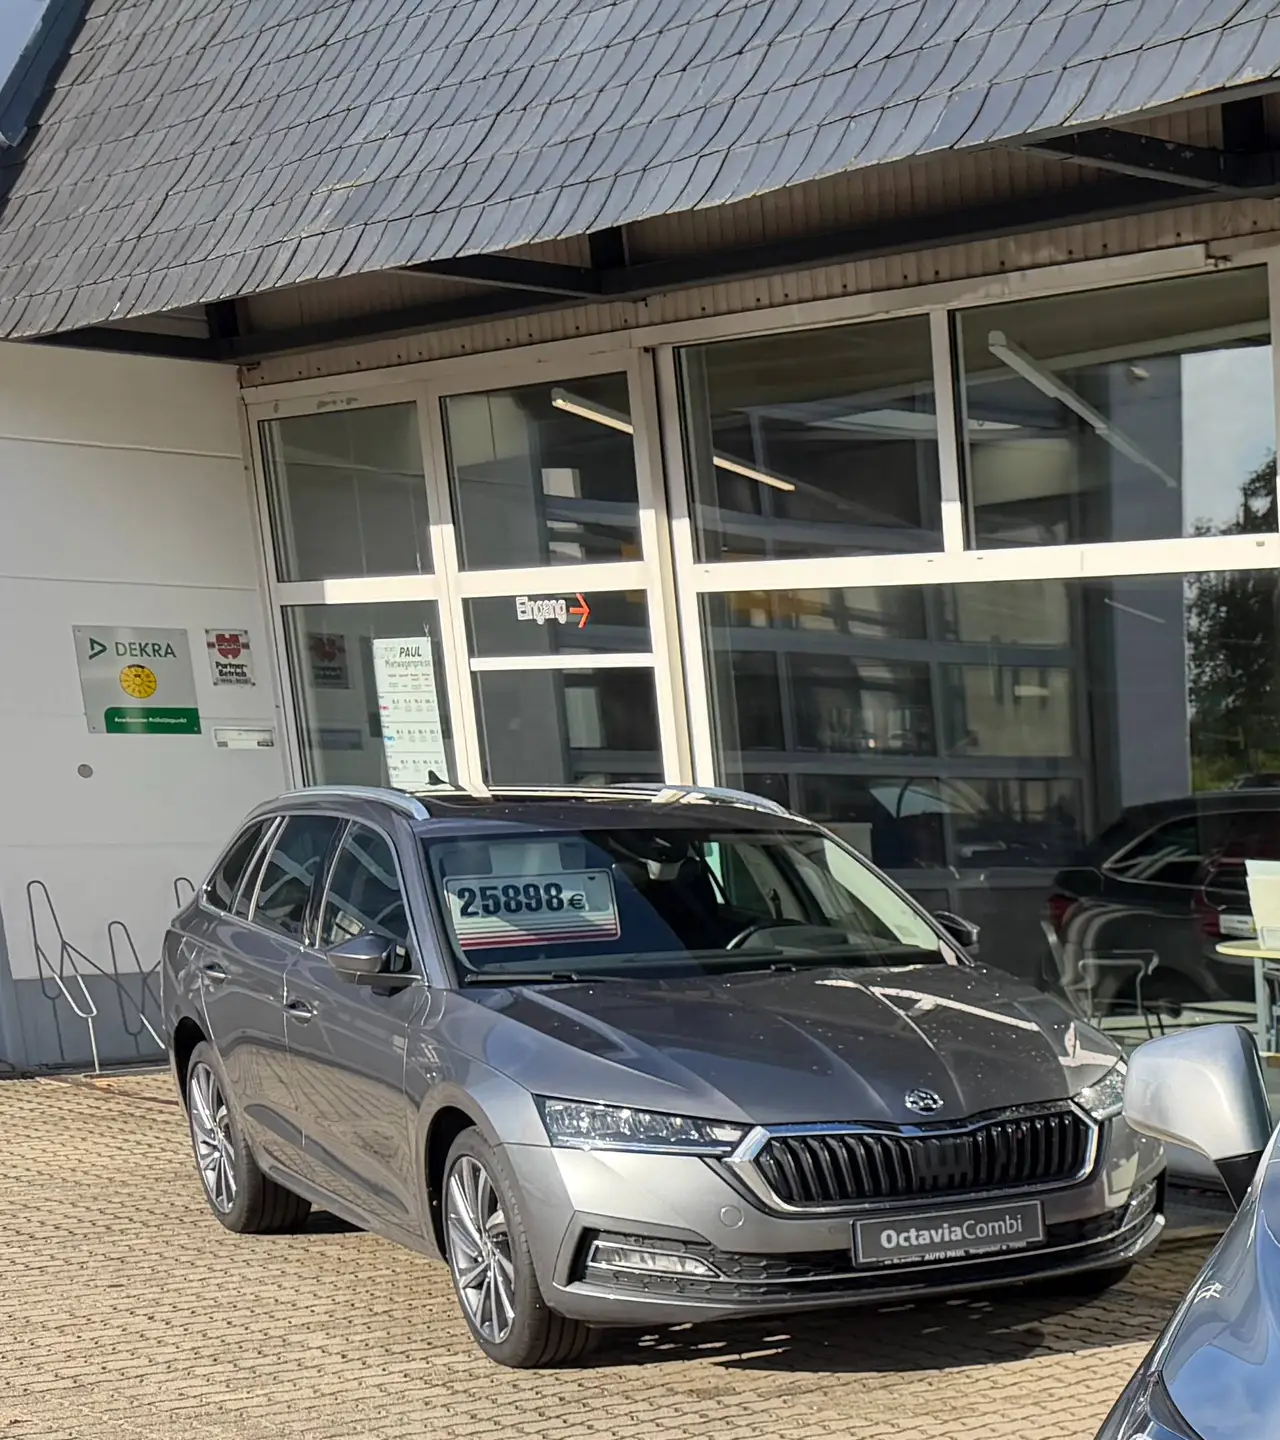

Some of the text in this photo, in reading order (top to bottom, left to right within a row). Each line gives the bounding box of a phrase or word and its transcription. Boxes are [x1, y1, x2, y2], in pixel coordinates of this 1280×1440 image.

[515, 596, 566, 624] Eingang
[114, 640, 177, 658] DEKRA
[399, 646, 422, 658] PAUL
[457, 882, 565, 916] 25898
[880, 1214, 1023, 1249] OctaviaCombi
